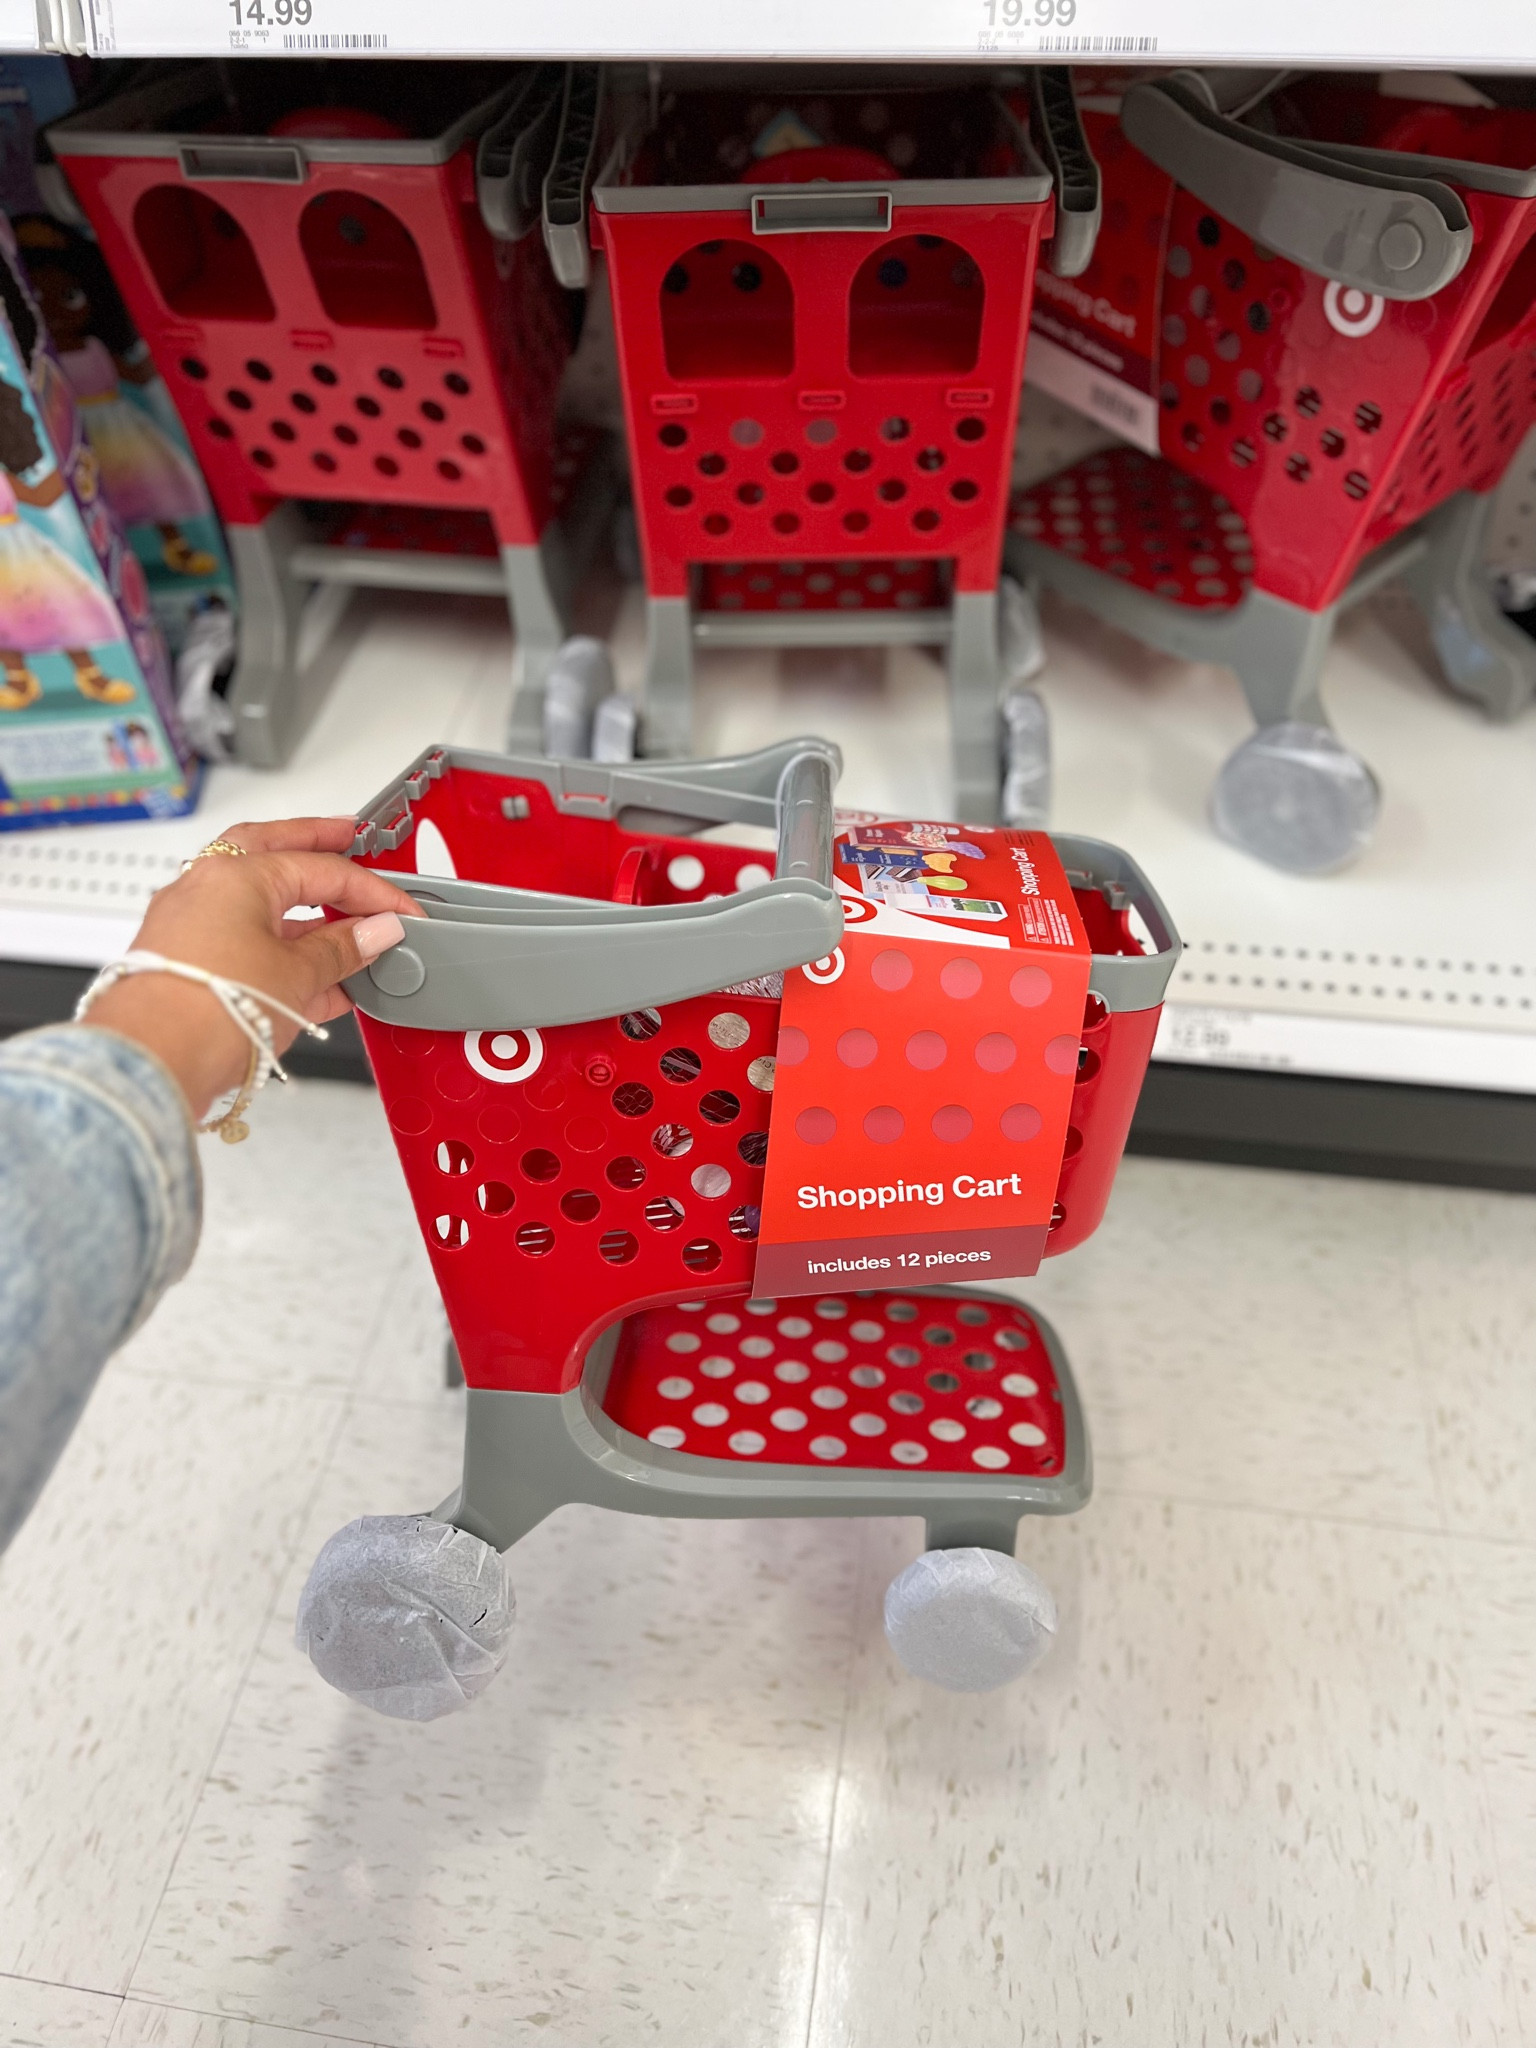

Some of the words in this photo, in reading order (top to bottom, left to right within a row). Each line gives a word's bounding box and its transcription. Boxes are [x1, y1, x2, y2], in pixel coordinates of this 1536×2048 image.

[229, 0, 312, 25] 14.99
[984, 0, 1076, 26] 19.99
[1009, 847, 1029, 863] Cart
[1016, 862, 1040, 896] Shopping
[797, 1179, 944, 1210] Shopping
[952, 1173, 1022, 1199] Cart
[807, 1255, 891, 1274] includes
[897, 1253, 921, 1267] 12
[925, 1250, 991, 1268] pieces
